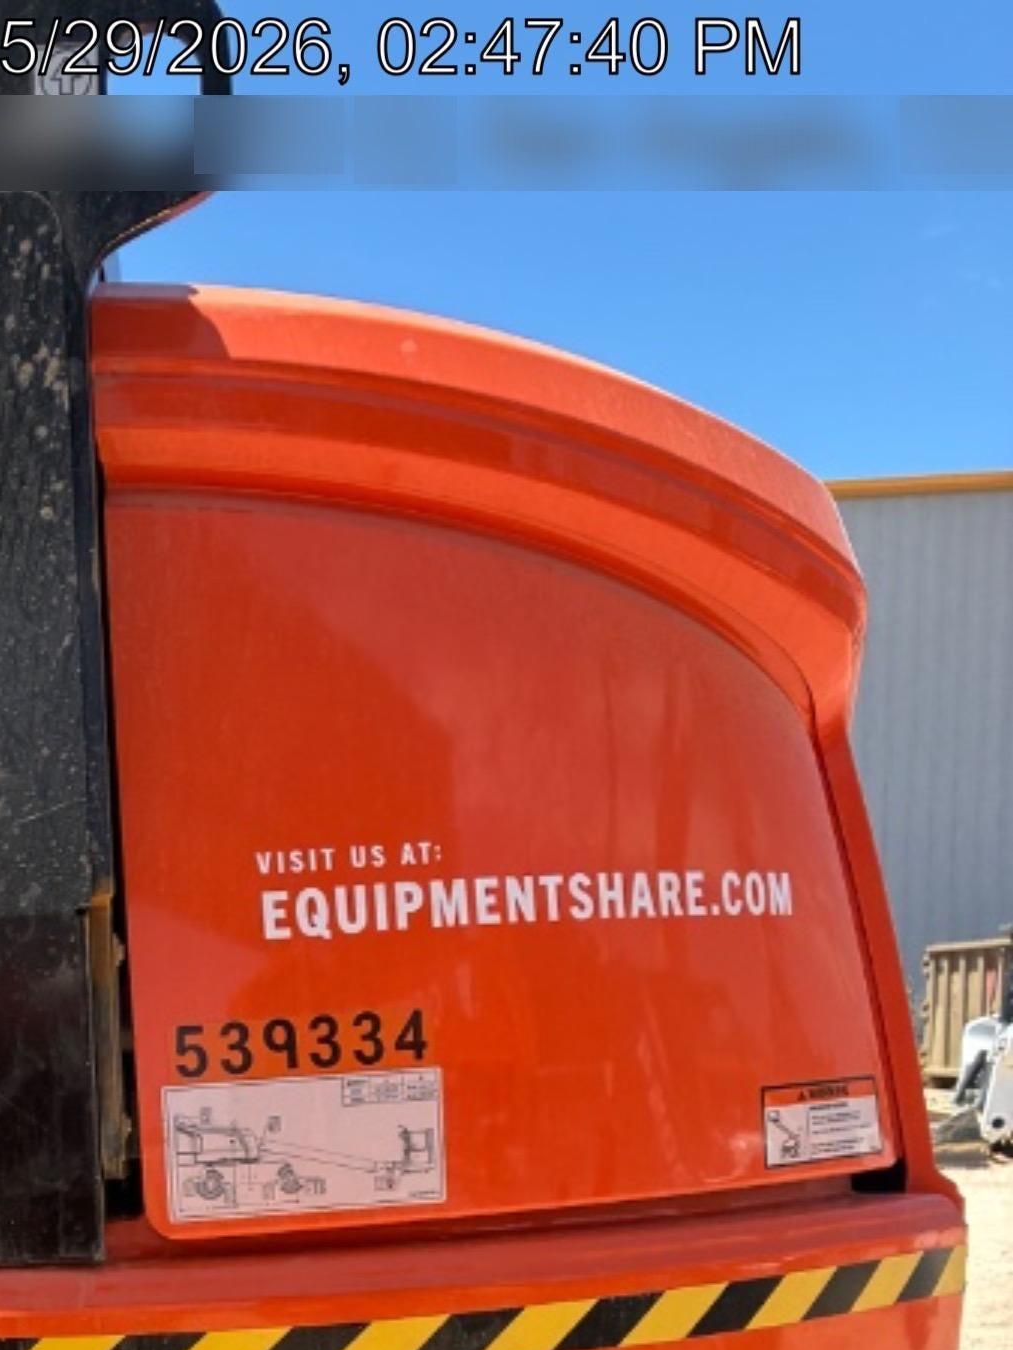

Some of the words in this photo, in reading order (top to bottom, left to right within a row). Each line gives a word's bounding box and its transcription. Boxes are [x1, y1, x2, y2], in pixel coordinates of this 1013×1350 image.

[256, 847, 336, 875] VISIT
[349, 844, 387, 867] US
[399, 841, 443, 866] AT:
[261, 870, 793, 940] EQUIPMENTSHARE.COM
[174, 1008, 429, 1078] 539334
